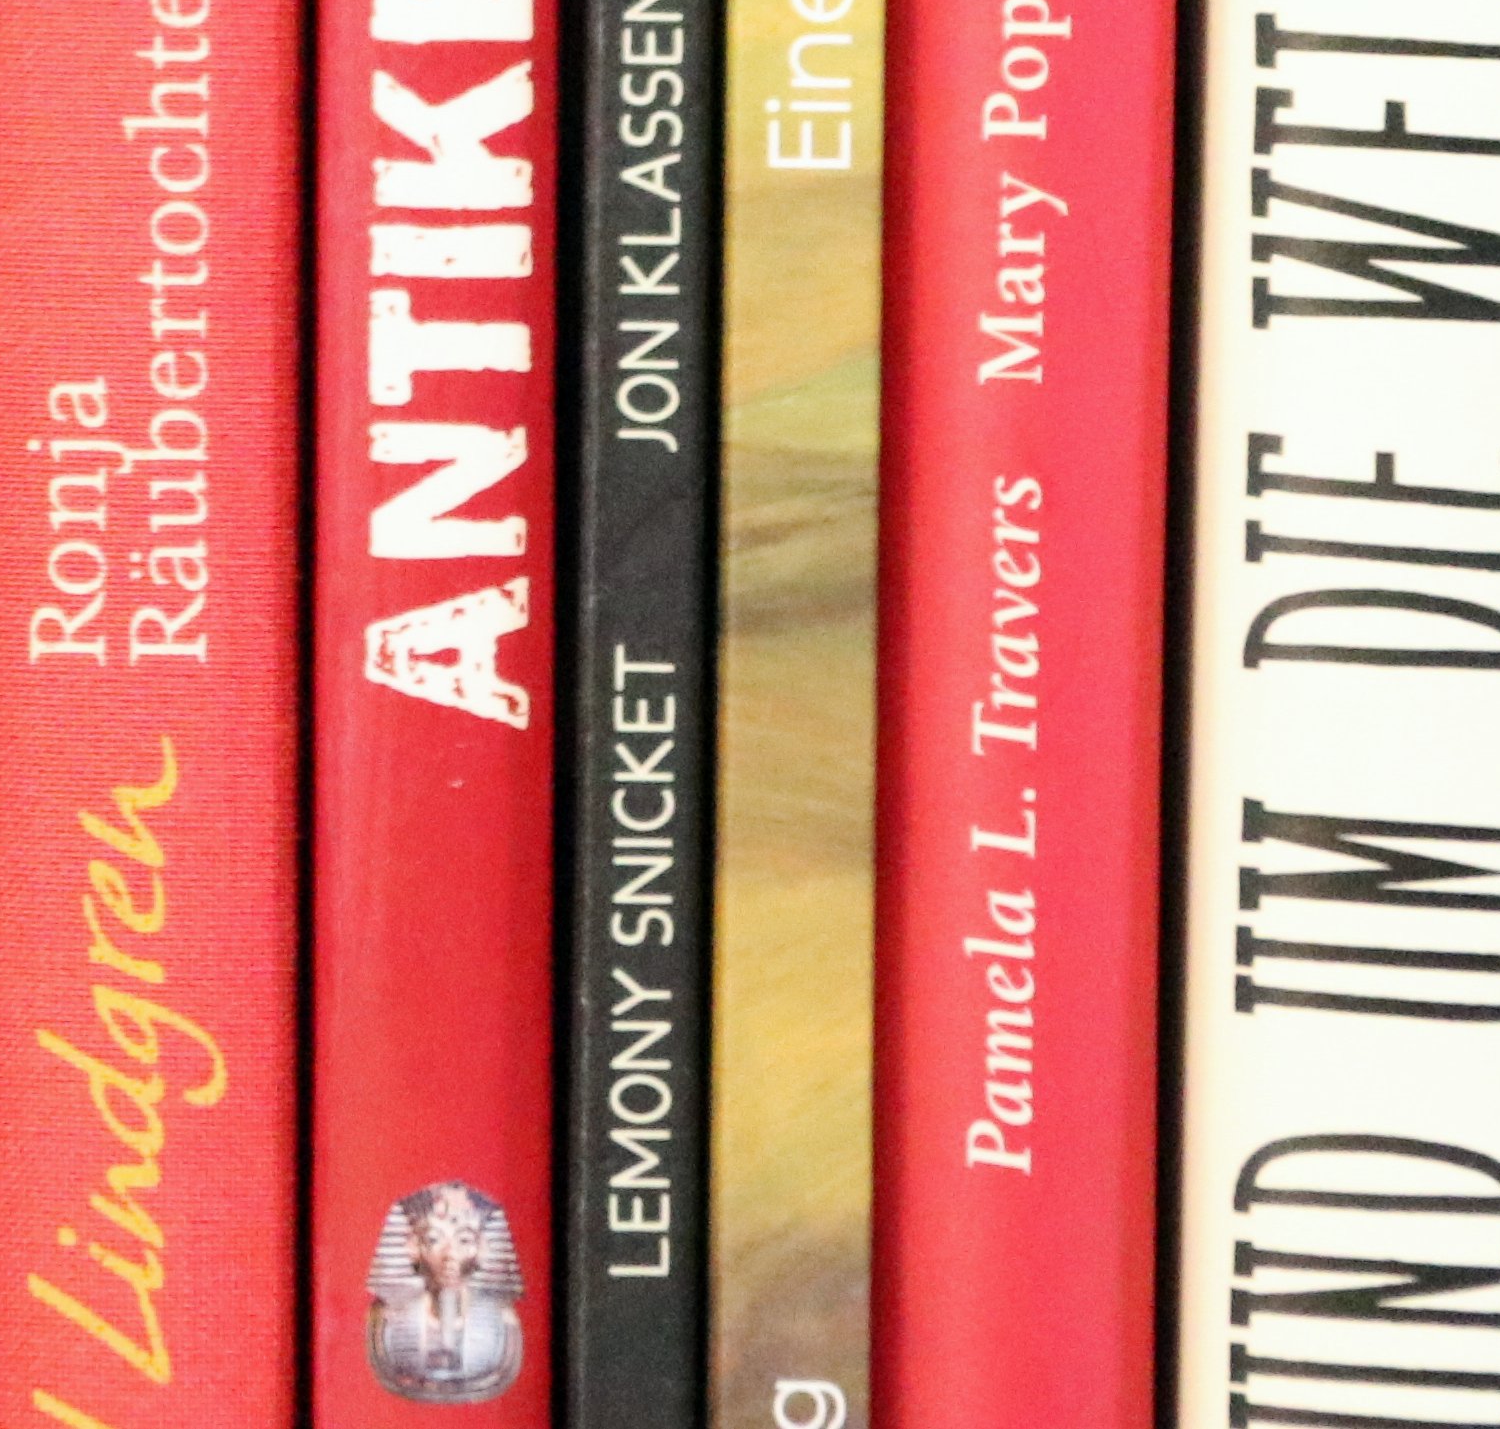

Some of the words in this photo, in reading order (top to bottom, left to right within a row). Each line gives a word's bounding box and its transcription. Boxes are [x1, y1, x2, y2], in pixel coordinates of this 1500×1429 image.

[616, 320, 681, 453] JON
[977, 171, 1069, 386] Mary
[28, 374, 137, 665] Ronja
[970, 475, 1044, 757] Travers
[611, 644, 678, 947] SNICKET
[970, 785, 1038, 861] L.
[27, 733, 228, 1385] Lindgren
[608, 968, 673, 1277] LEMONY
[963, 890, 1036, 1176] Pamela
